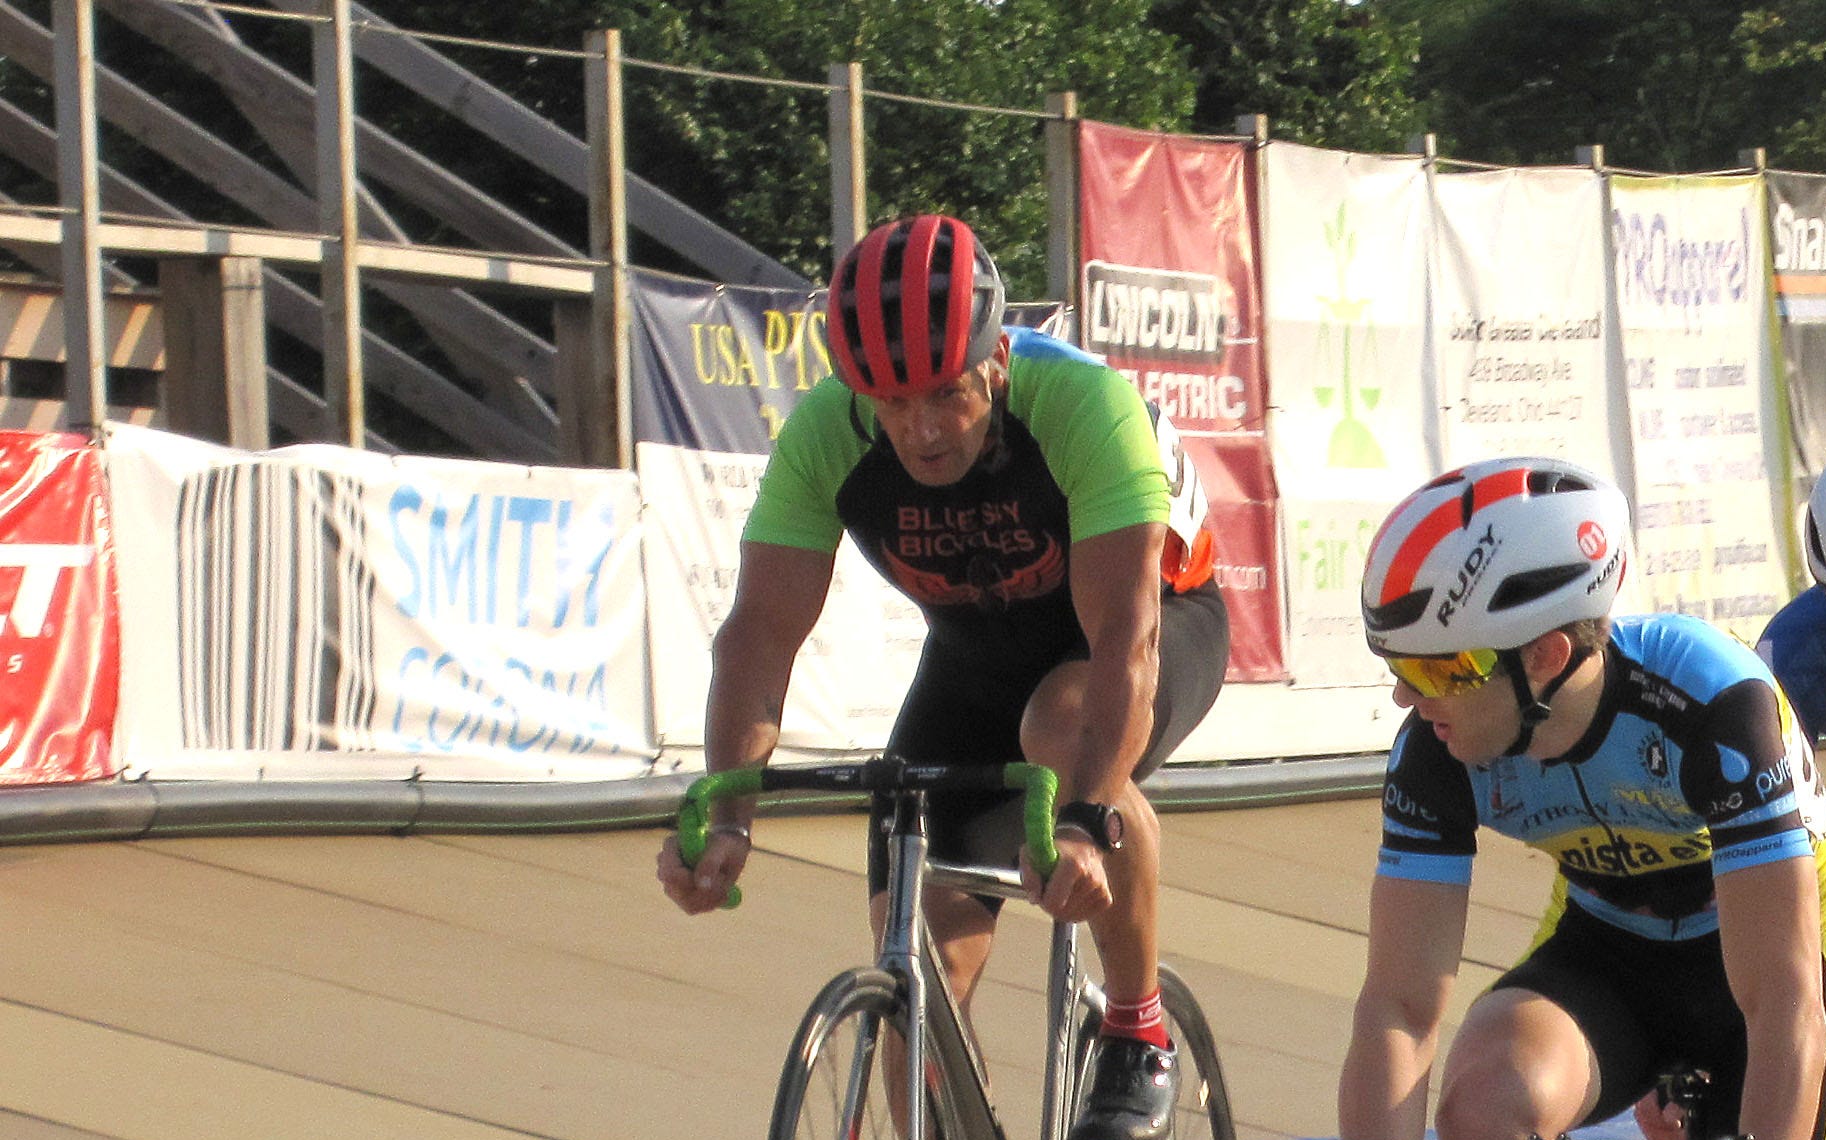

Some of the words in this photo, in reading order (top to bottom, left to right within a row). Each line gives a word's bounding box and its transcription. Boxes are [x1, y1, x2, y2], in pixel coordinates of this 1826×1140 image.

[689, 323, 761, 387] USA
[761, 308, 836, 393] PIS
[1089, 278, 1220, 353] LINCOLN
[388, 484, 617, 631] SMITH
[898, 529, 1037, 558] BICYCLES
[1436, 523, 1496, 628] RUDY
[1586, 548, 1620, 596] RUDY
[0, 543, 92, 638] T
[1561, 834, 1664, 880] pista
